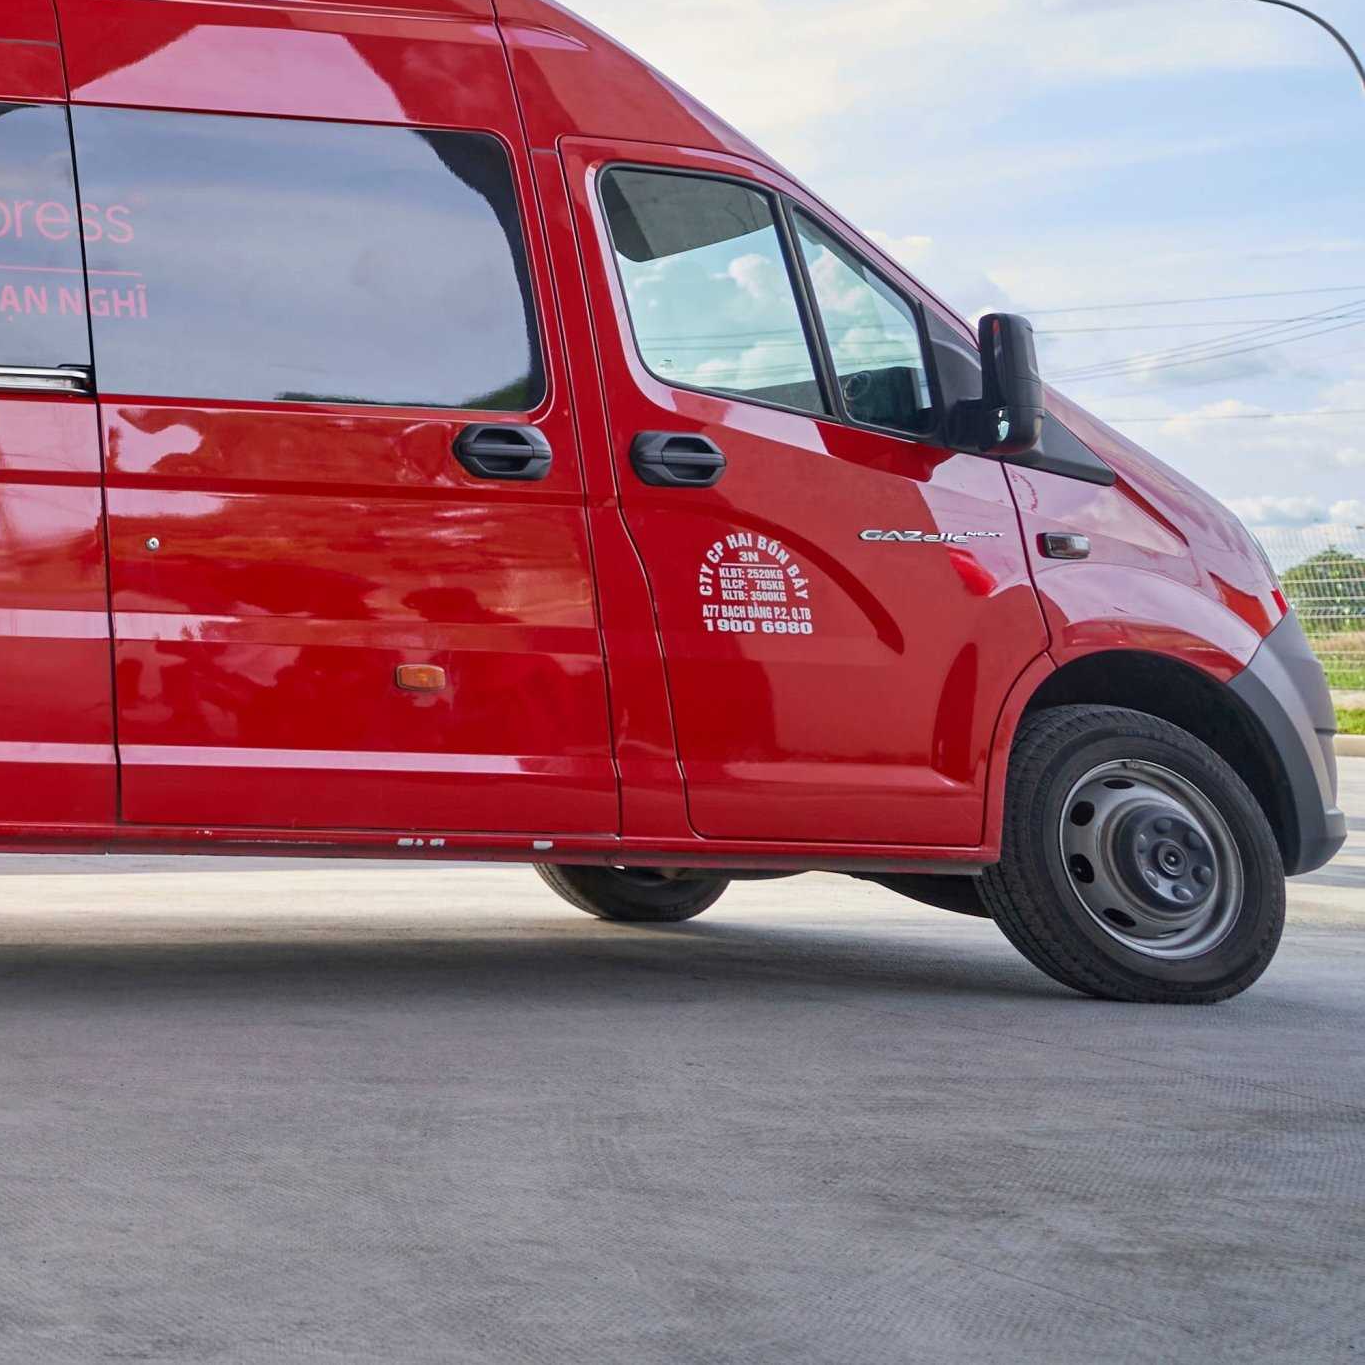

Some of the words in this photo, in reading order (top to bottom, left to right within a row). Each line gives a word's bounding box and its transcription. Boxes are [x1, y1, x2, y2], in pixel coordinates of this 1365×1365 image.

[58, 284, 149, 318] NGHĨ
[726, 532, 753, 550] HAI
[706, 541, 724, 564] CP
[738, 551, 760, 562] 3N
[757, 535, 790, 565] BỐN
[699, 563, 714, 596] CTY
[719, 566, 745, 578] KLBT:
[746, 568, 784, 580] 2520KG
[786, 564, 810, 599] BẢY
[720, 578, 749, 590] KLCP:
[754, 579, 785, 591] 785KG
[722, 589, 749, 601] KLTB:
[750, 590, 787, 602] 3500KG
[702, 604, 719, 618] A77
[703, 618, 756, 633] 1900
[761, 620, 814, 635] 6980
